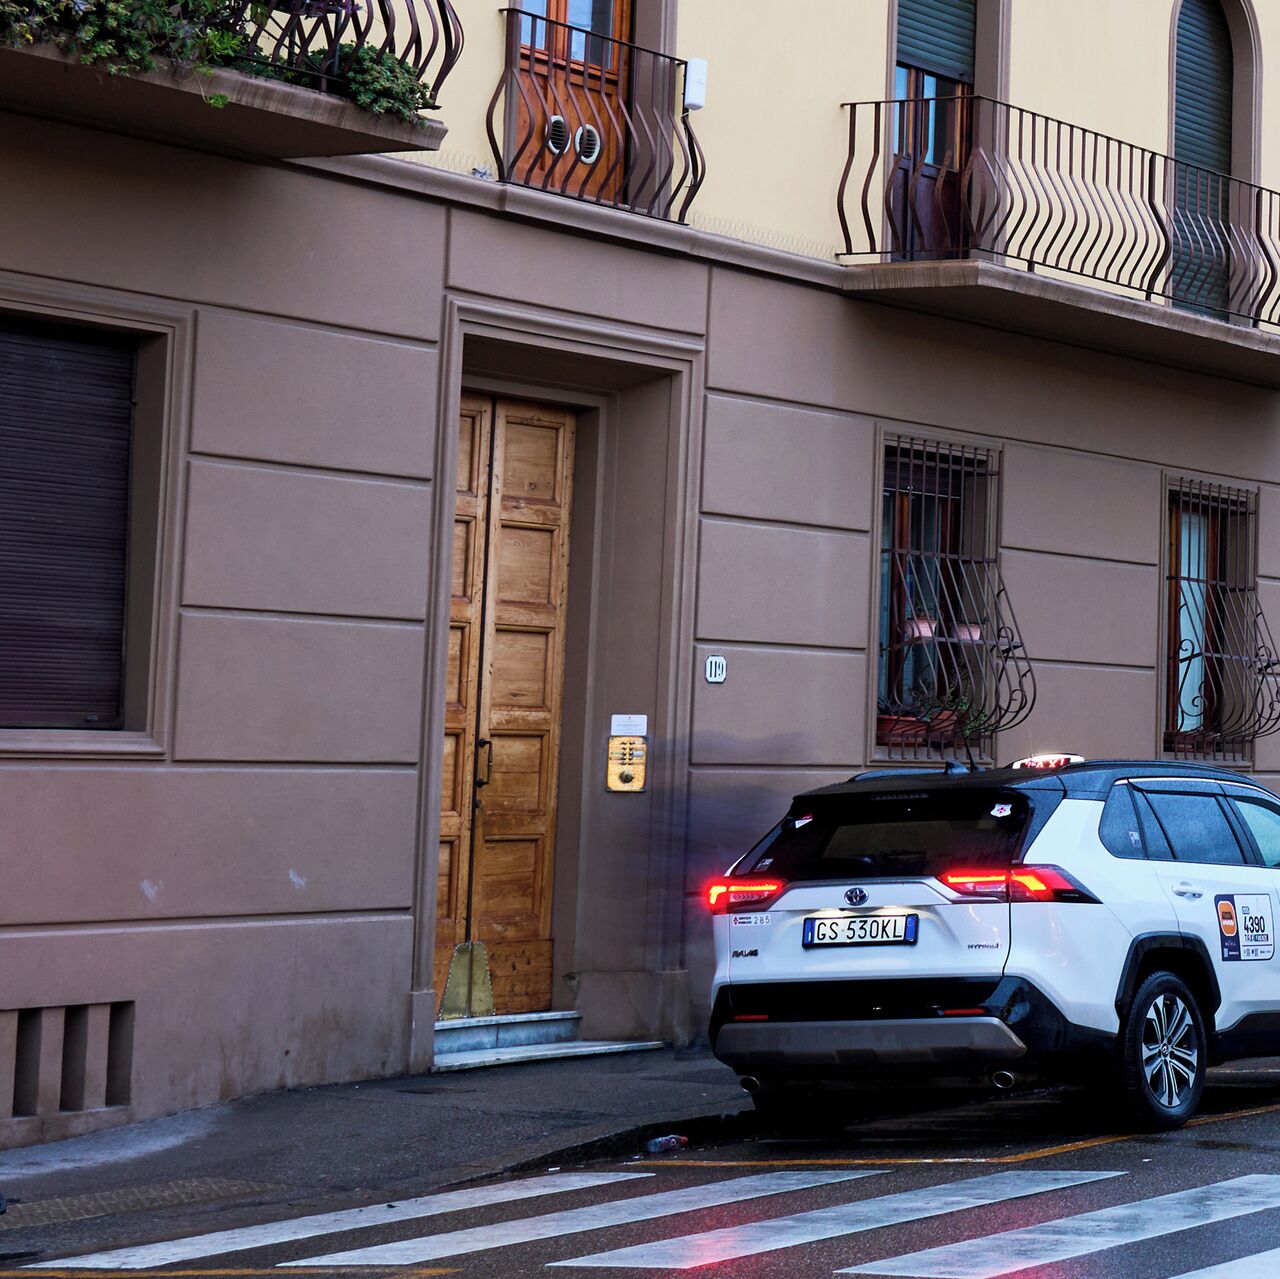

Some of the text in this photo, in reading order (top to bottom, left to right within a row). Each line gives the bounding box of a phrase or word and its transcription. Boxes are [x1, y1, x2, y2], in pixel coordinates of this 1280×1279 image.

[709, 660, 725, 678] 119
[753, 915, 770, 925] 285
[1243, 915, 1266, 934] 4390
[816, 918, 903, 941] GS 530KL
